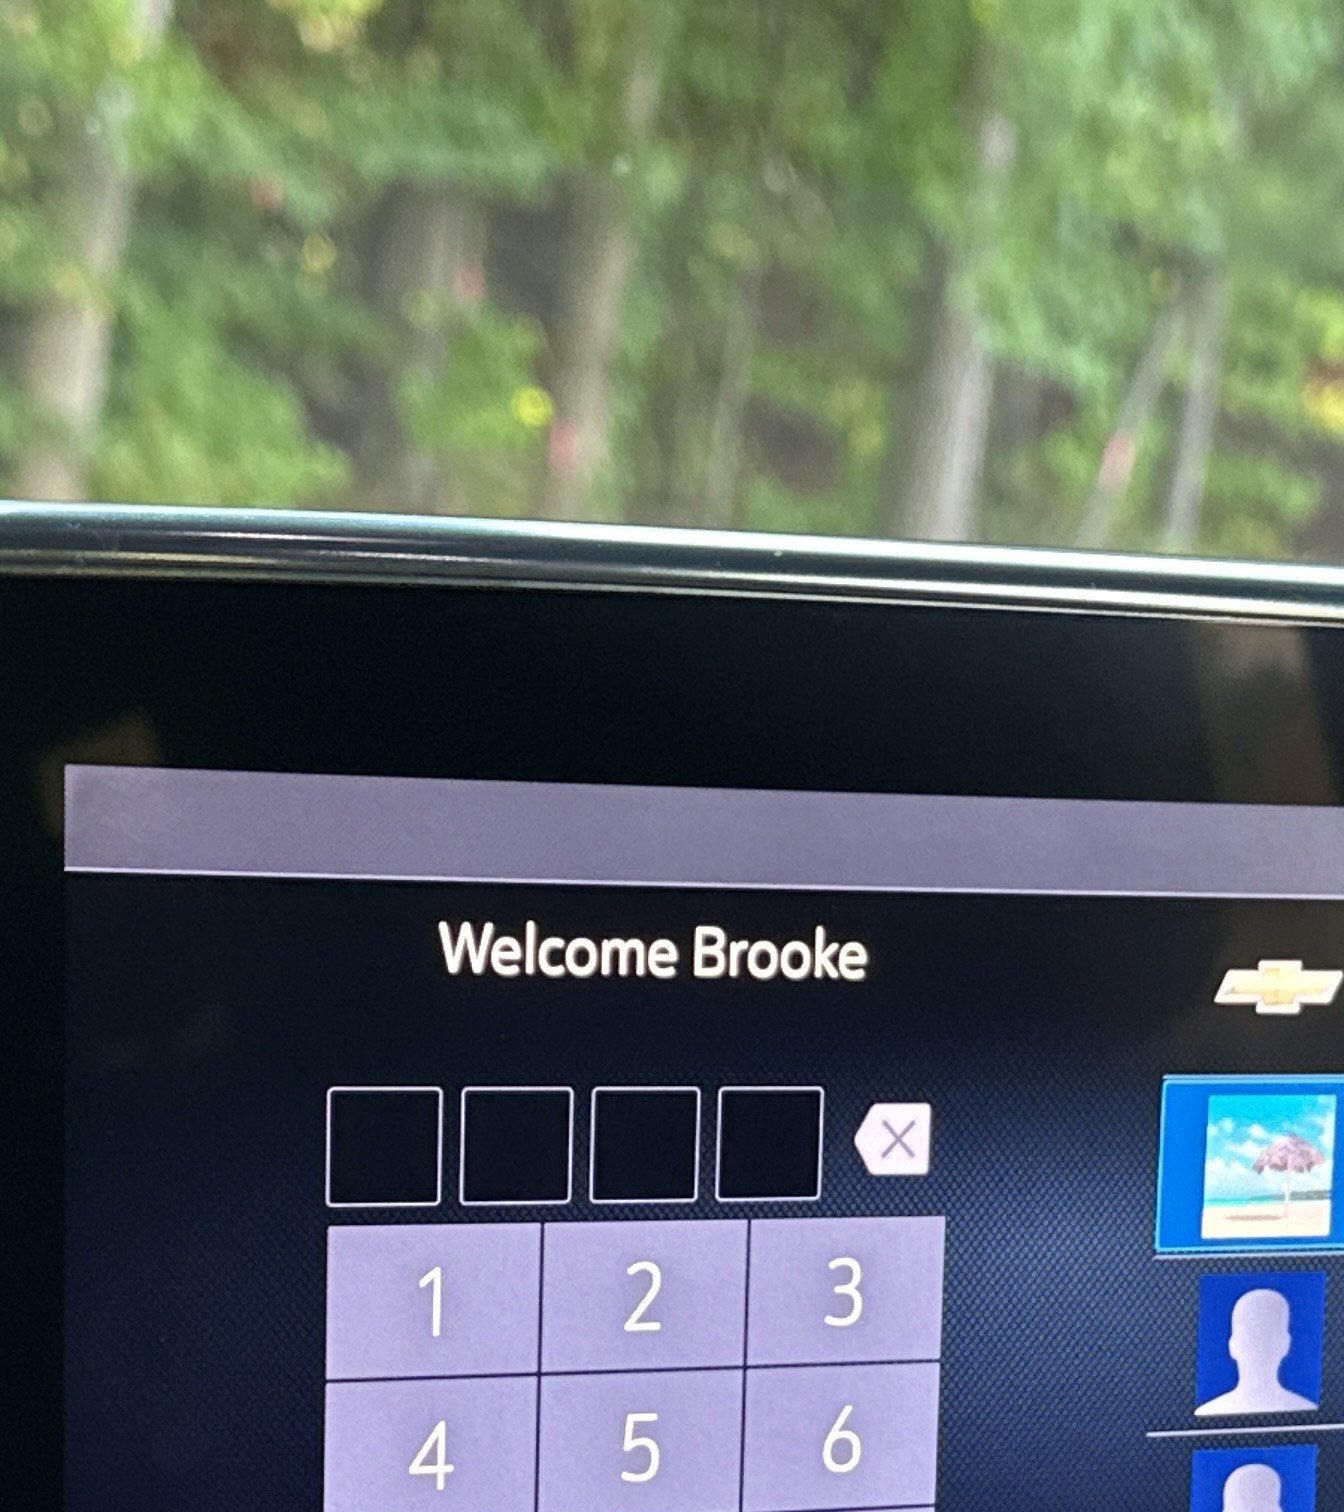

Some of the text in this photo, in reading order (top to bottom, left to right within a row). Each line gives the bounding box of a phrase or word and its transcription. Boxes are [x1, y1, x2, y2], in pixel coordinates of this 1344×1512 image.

[437, 918, 870, 982] Welcome Brooke
[417, 1265, 443, 1339] 1
[622, 1259, 663, 1333] 2
[822, 1256, 864, 1328] 3
[407, 1419, 456, 1492] 4
[619, 1411, 661, 1484] 5
[821, 1403, 863, 1474] 6
